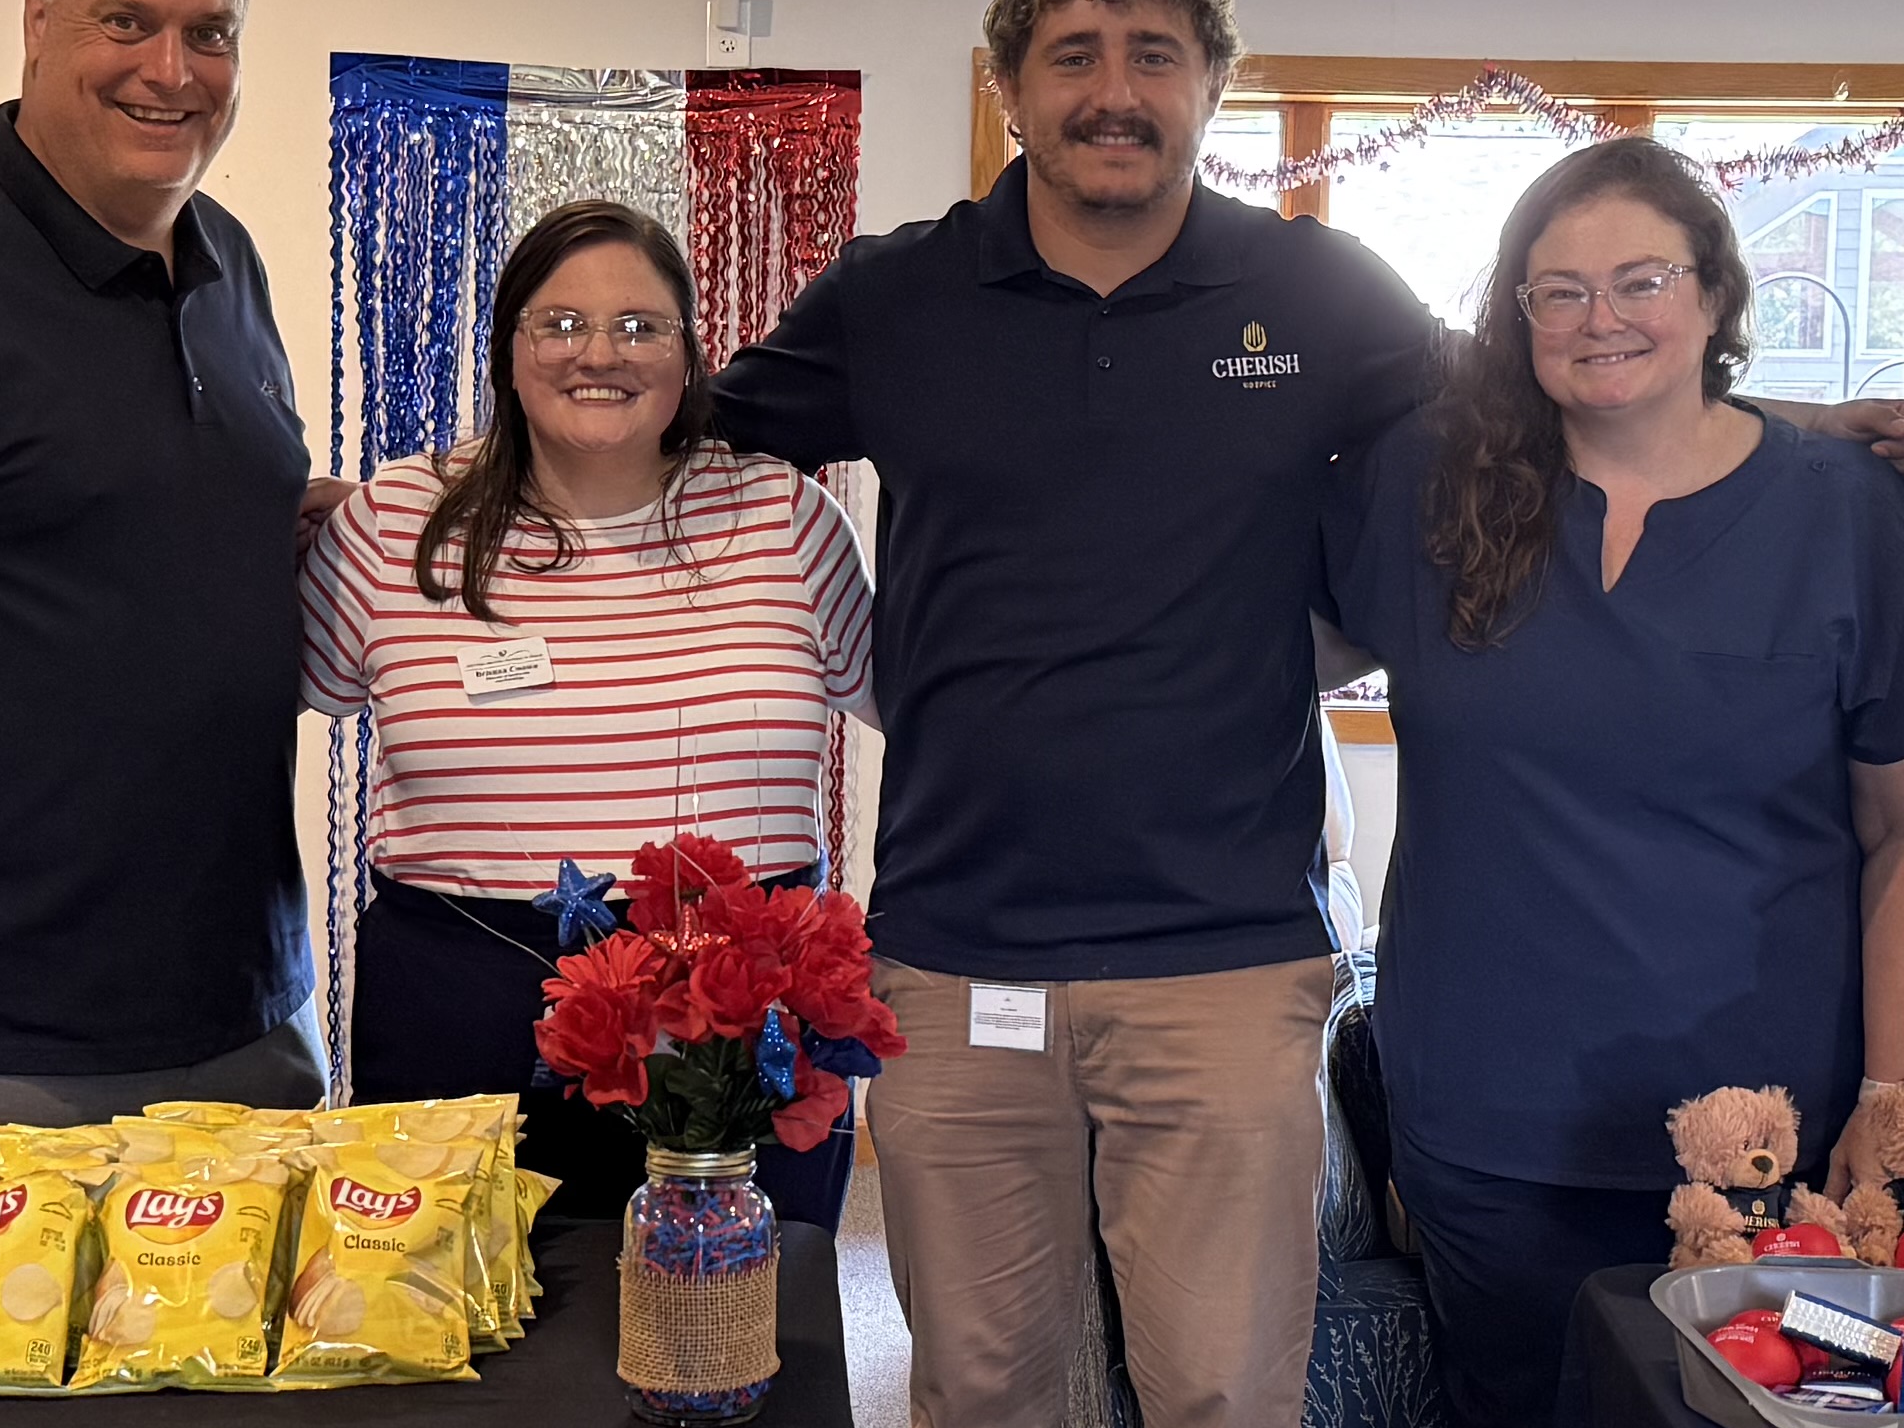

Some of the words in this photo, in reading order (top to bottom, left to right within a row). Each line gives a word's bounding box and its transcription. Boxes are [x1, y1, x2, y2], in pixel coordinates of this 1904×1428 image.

[1212, 354, 1300, 378] CHERISH
[130, 1190, 219, 1228] Lay's
[336, 1180, 418, 1220] Lay's
[344, 1235, 406, 1253] Classic
[137, 1252, 201, 1267] Classic
[31, 1341, 51, 1356] 240
